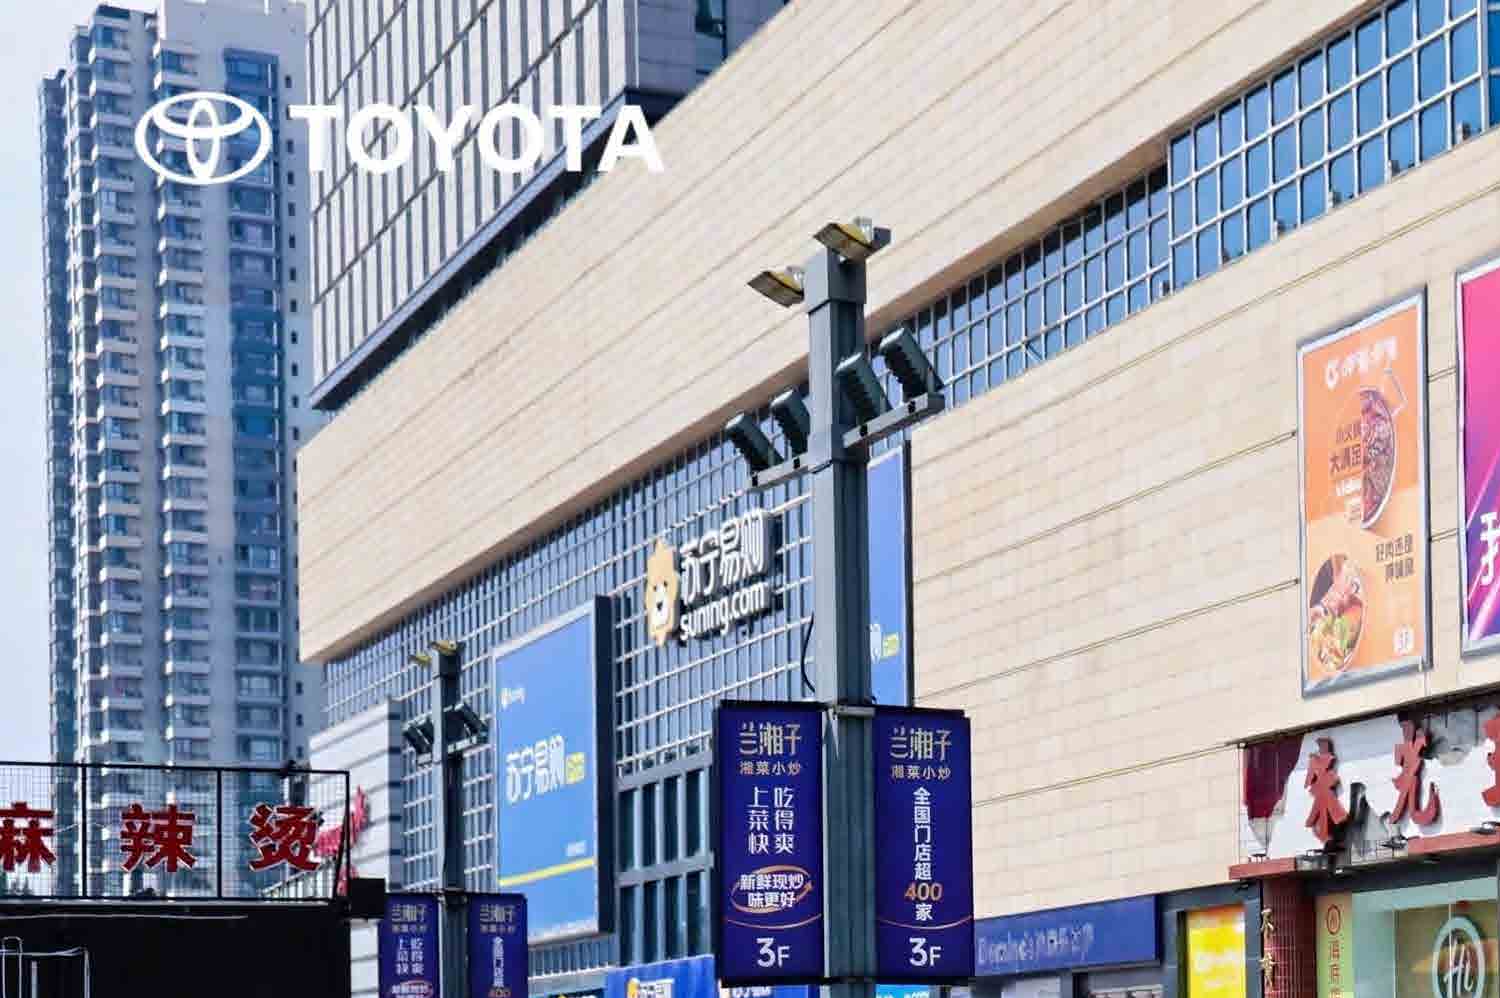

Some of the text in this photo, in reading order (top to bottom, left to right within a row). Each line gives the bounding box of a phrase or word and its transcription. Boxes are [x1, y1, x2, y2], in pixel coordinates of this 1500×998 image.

[680, 508, 766, 604] 苏宁易购
[679, 581, 766, 641] suning.com
[738, 721, 802, 756] 兰湘子
[890, 727, 952, 761] 兰湘子
[738, 760, 802, 776] 湘菜小炒
[891, 765, 952, 781] 湘菜小炒
[0, 801, 322, 874] 麻辣烫
[747, 786, 769, 855] 上菜快
[773, 786, 794, 855] 吃得爽
[739, 873, 804, 892] 新鲜现炒
[747, 891, 797, 909] 味更好
[756, 937, 792, 968] 3F
[908, 937, 942, 967] 3F
